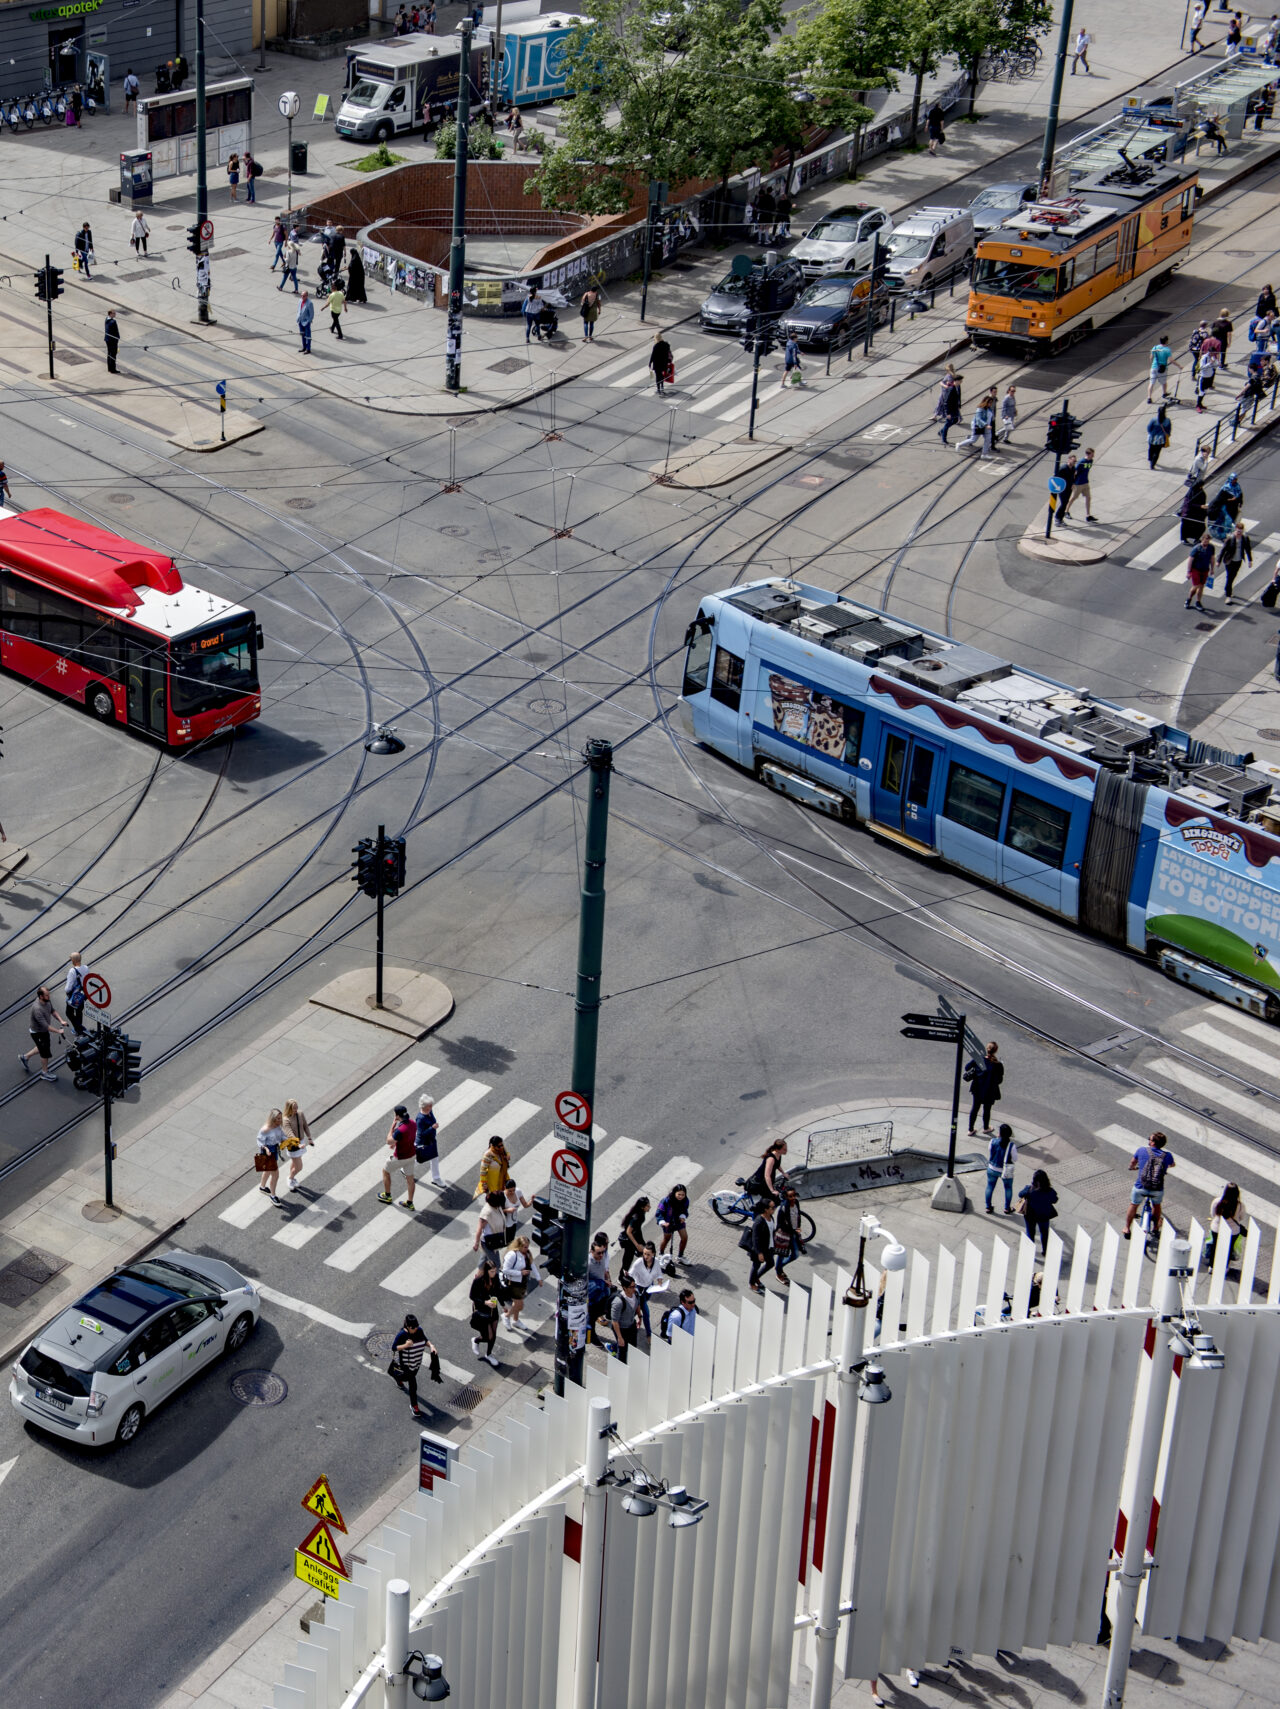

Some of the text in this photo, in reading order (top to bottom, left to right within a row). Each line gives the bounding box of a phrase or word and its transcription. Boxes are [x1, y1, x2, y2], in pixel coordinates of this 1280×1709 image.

[282, 99, 289, 114] T
[200, 634, 220, 649] Grorud
[1159, 858, 1209, 889] FROM
[1162, 847, 1217, 877] LAYERED
[1219, 870, 1252, 893] WITH
[1157, 873, 1186, 898] TO
[556, 1124, 588, 1142] Gjelder ikke
[556, 1132, 570, 1142] buss
[304, 1559, 339, 1585] Anleggs
[308, 1572, 336, 1595] trafikk
